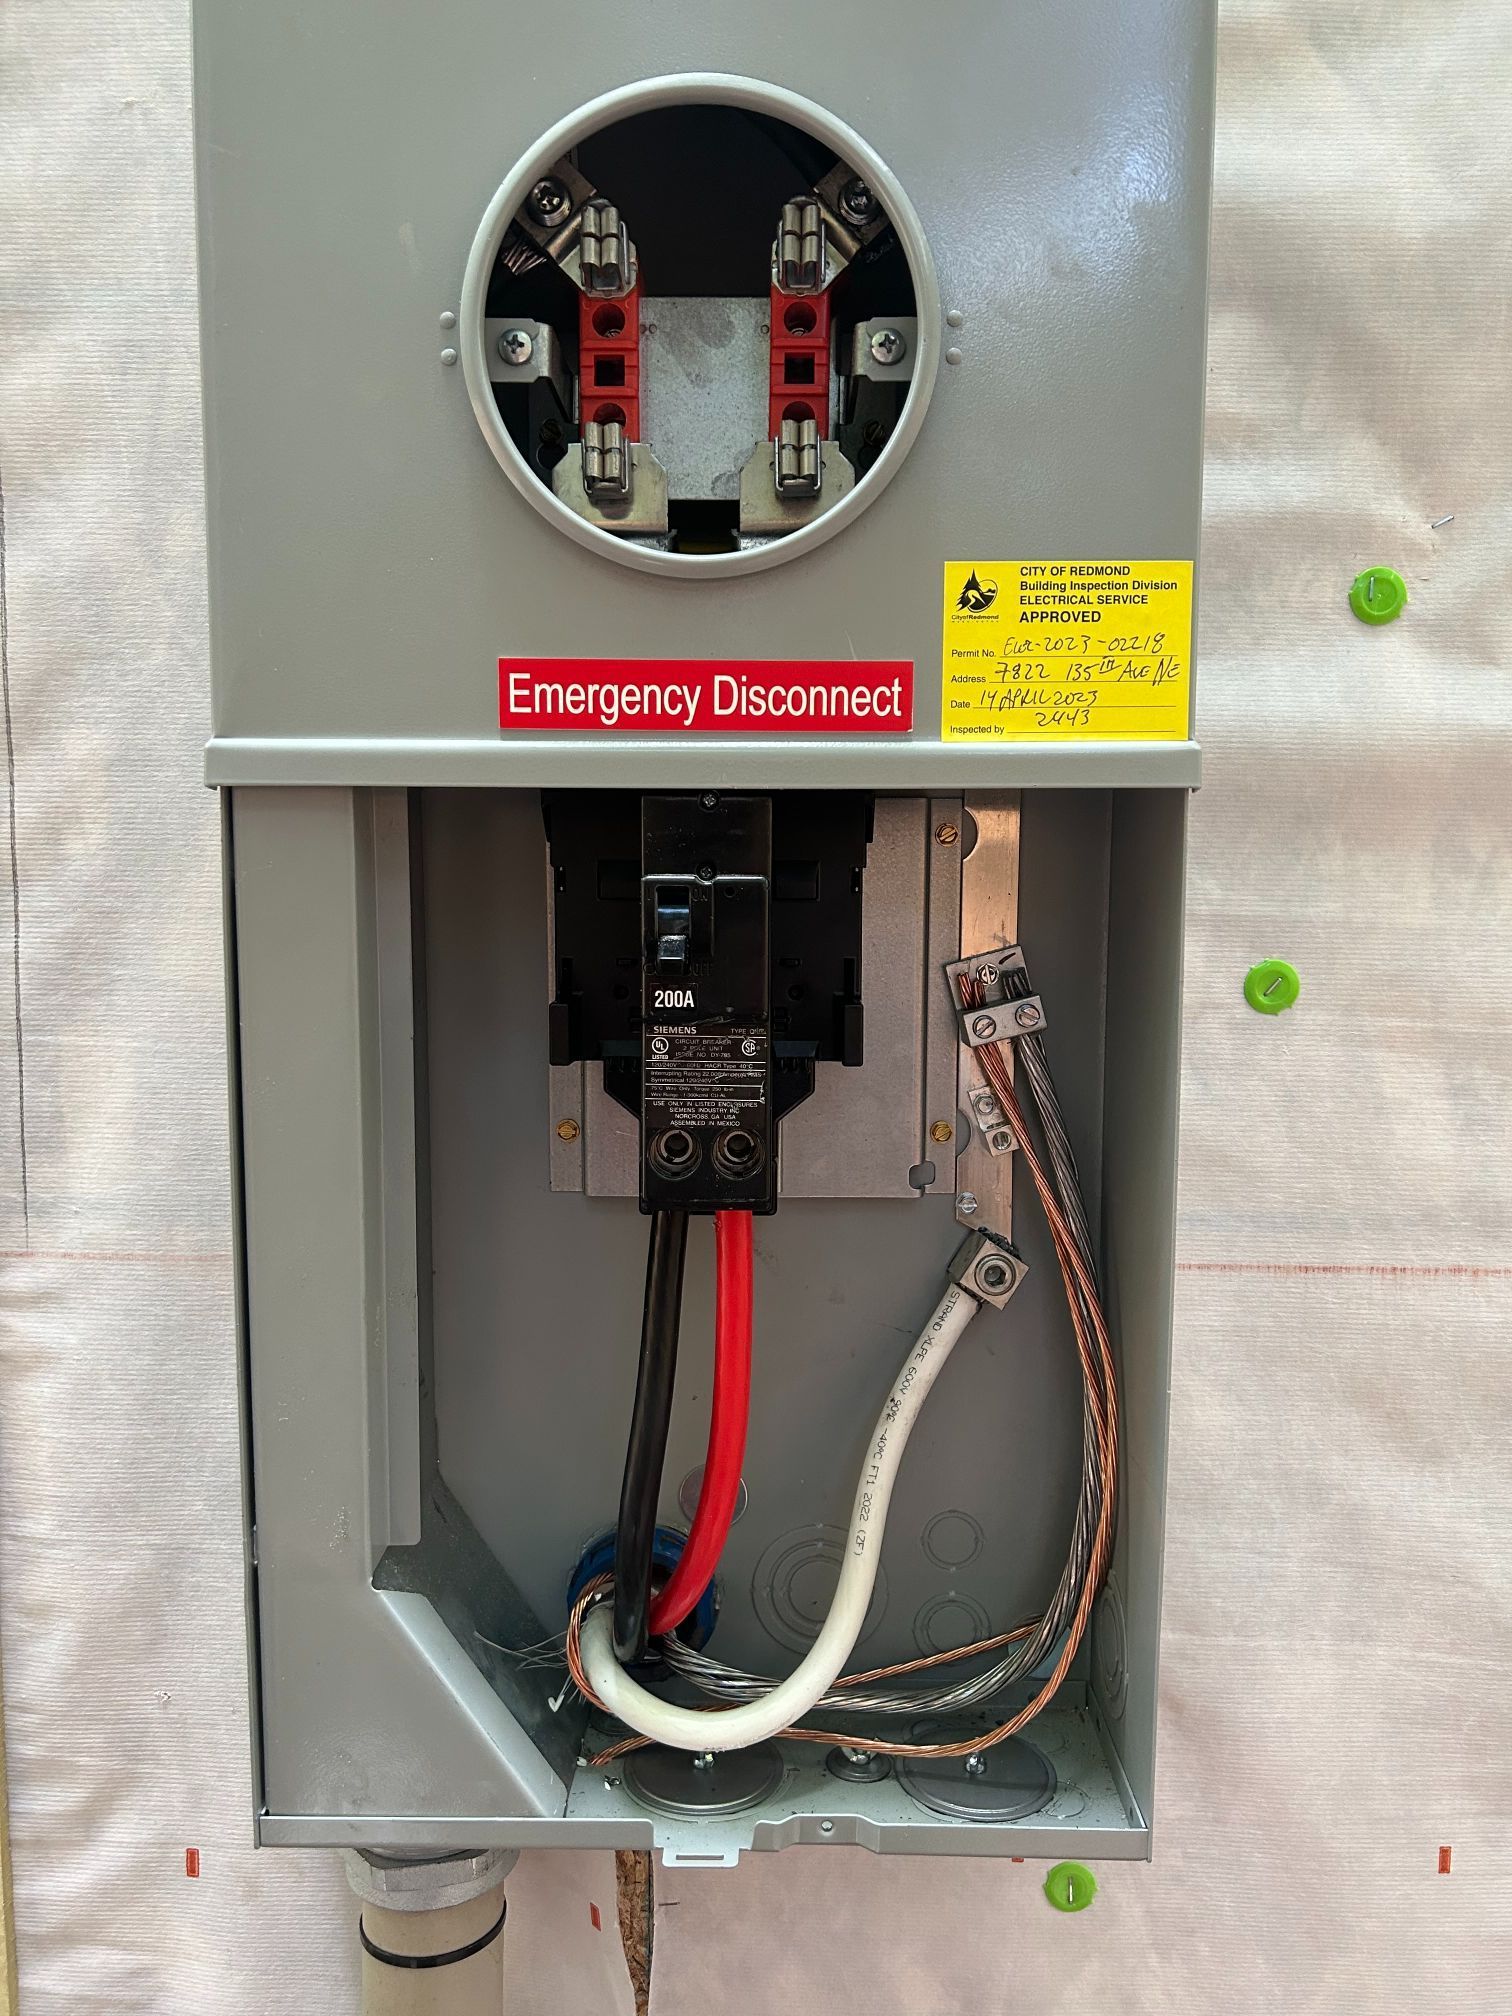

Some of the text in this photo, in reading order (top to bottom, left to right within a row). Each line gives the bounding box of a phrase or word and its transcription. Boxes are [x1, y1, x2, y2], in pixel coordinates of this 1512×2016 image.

[1020, 566, 1131, 576] CITY OF REDMOND
[1020, 580, 1178, 593] Building Inspection Division
[1020, 594, 1149, 605] ELECTRICAL SERVICE
[1019, 610, 1102, 623] APPROVED
[951, 648, 997, 658] Permit No.
[950, 674, 987, 683] Address
[994, 661, 1051, 683] 7822
[508, 672, 903, 726] Emergency Disconnect
[950, 699, 971, 709] Date
[980, 689, 998, 711] 14
[1053, 690, 1099, 707] 2023
[950, 724, 1005, 735] Inspected by
[654, 990, 695, 1008] 200A
[653, 1025, 697, 1034] SIEMENS
[932, 1290, 961, 1332] STRAND
[914, 1334, 936, 1362] XLPE
[899, 1366, 918, 1395] 600V
[866, 1465, 880, 1486] FT1
[859, 1492, 873, 1522] 2022
